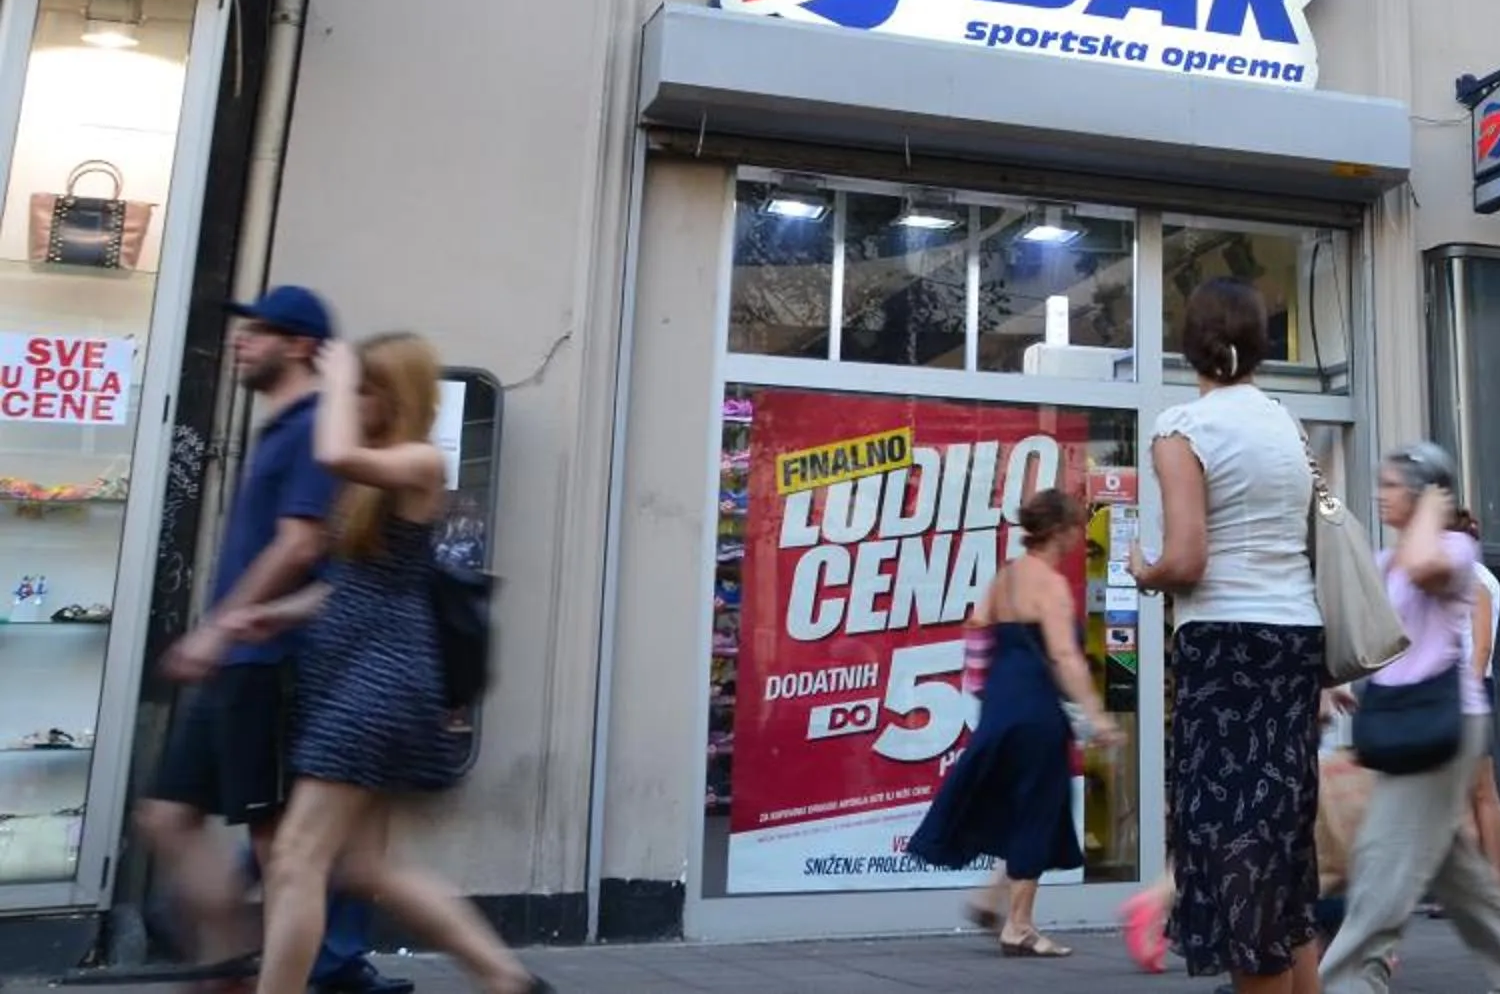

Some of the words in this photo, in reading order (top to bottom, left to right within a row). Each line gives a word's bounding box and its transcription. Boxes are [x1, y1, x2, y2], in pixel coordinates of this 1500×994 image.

[964, 21, 1149, 61] sportska
[1161, 46, 1305, 83] oprema
[25, 337, 108, 368] SVE
[0, 365, 23, 389] U
[33, 367, 121, 394] POLA
[1, 391, 116, 421] CENE
[783, 435, 907, 487] FINALNO
[779, 435, 1059, 549] LUDILO
[765, 663, 880, 701] DODATNIH
[828, 704, 872, 731] DO
[803, 853, 866, 876] SNIŽENJE
